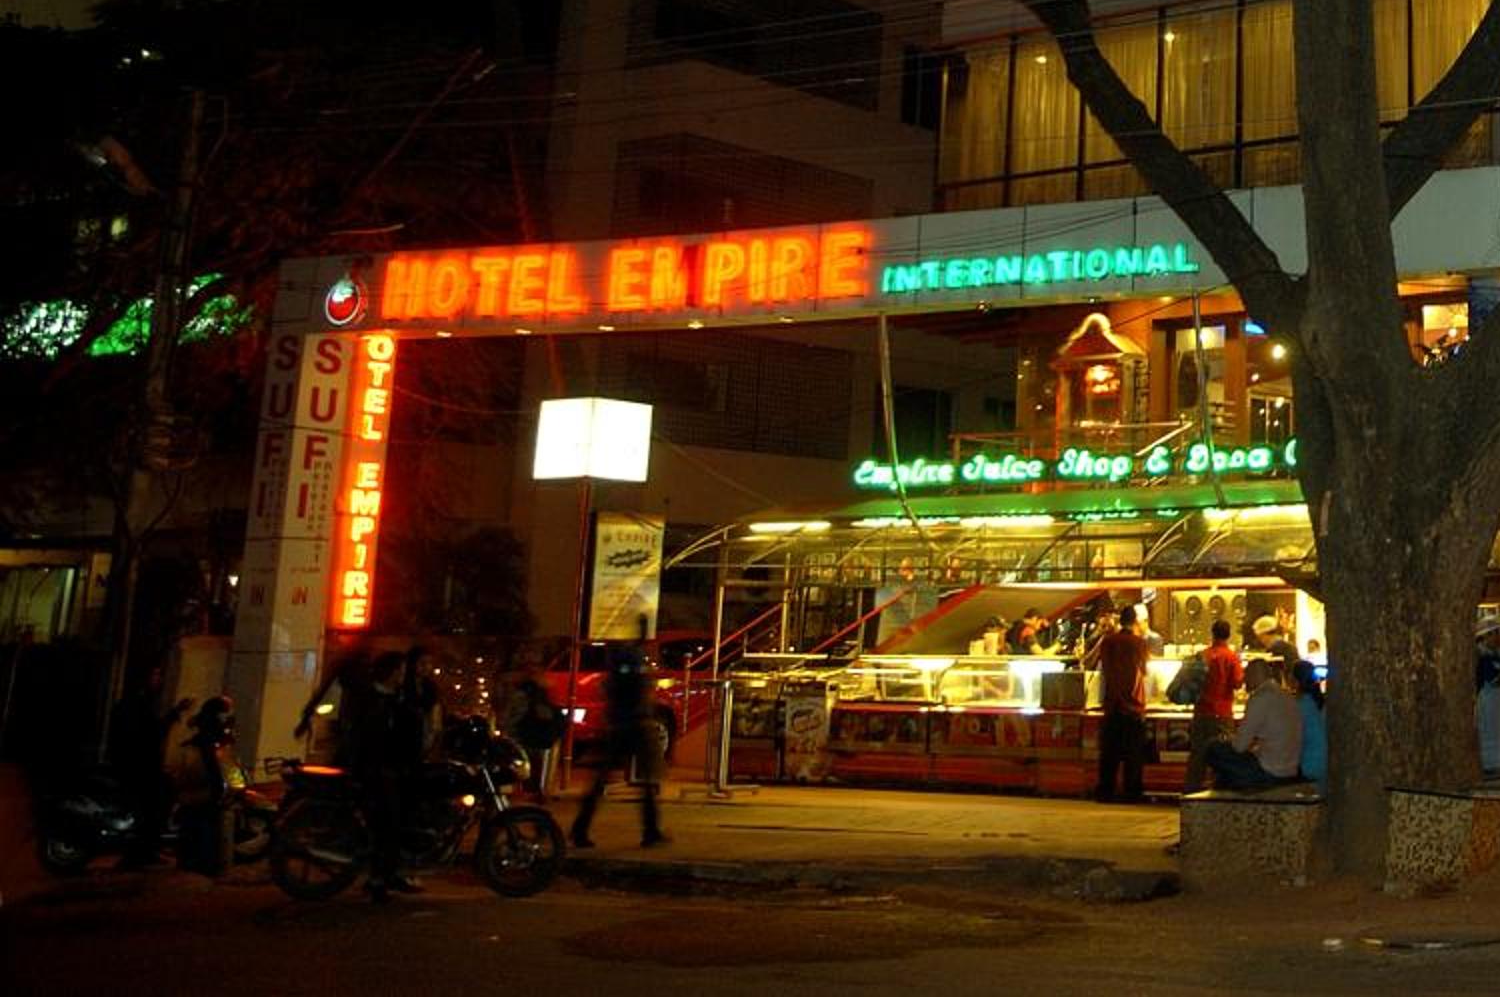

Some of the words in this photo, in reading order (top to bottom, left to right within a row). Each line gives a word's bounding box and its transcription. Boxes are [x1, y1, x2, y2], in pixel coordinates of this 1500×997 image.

[382, 249, 586, 319] HOTEL
[605, 231, 868, 312] EMPIRE
[882, 244, 1198, 294] INTERNATIONAL
[298, 339, 342, 517] SUFI
[361, 334, 394, 440] OTEL
[963, 453, 1044, 483] Juice
[1058, 447, 1133, 483] Shop
[342, 462, 381, 625] EMPIRE
